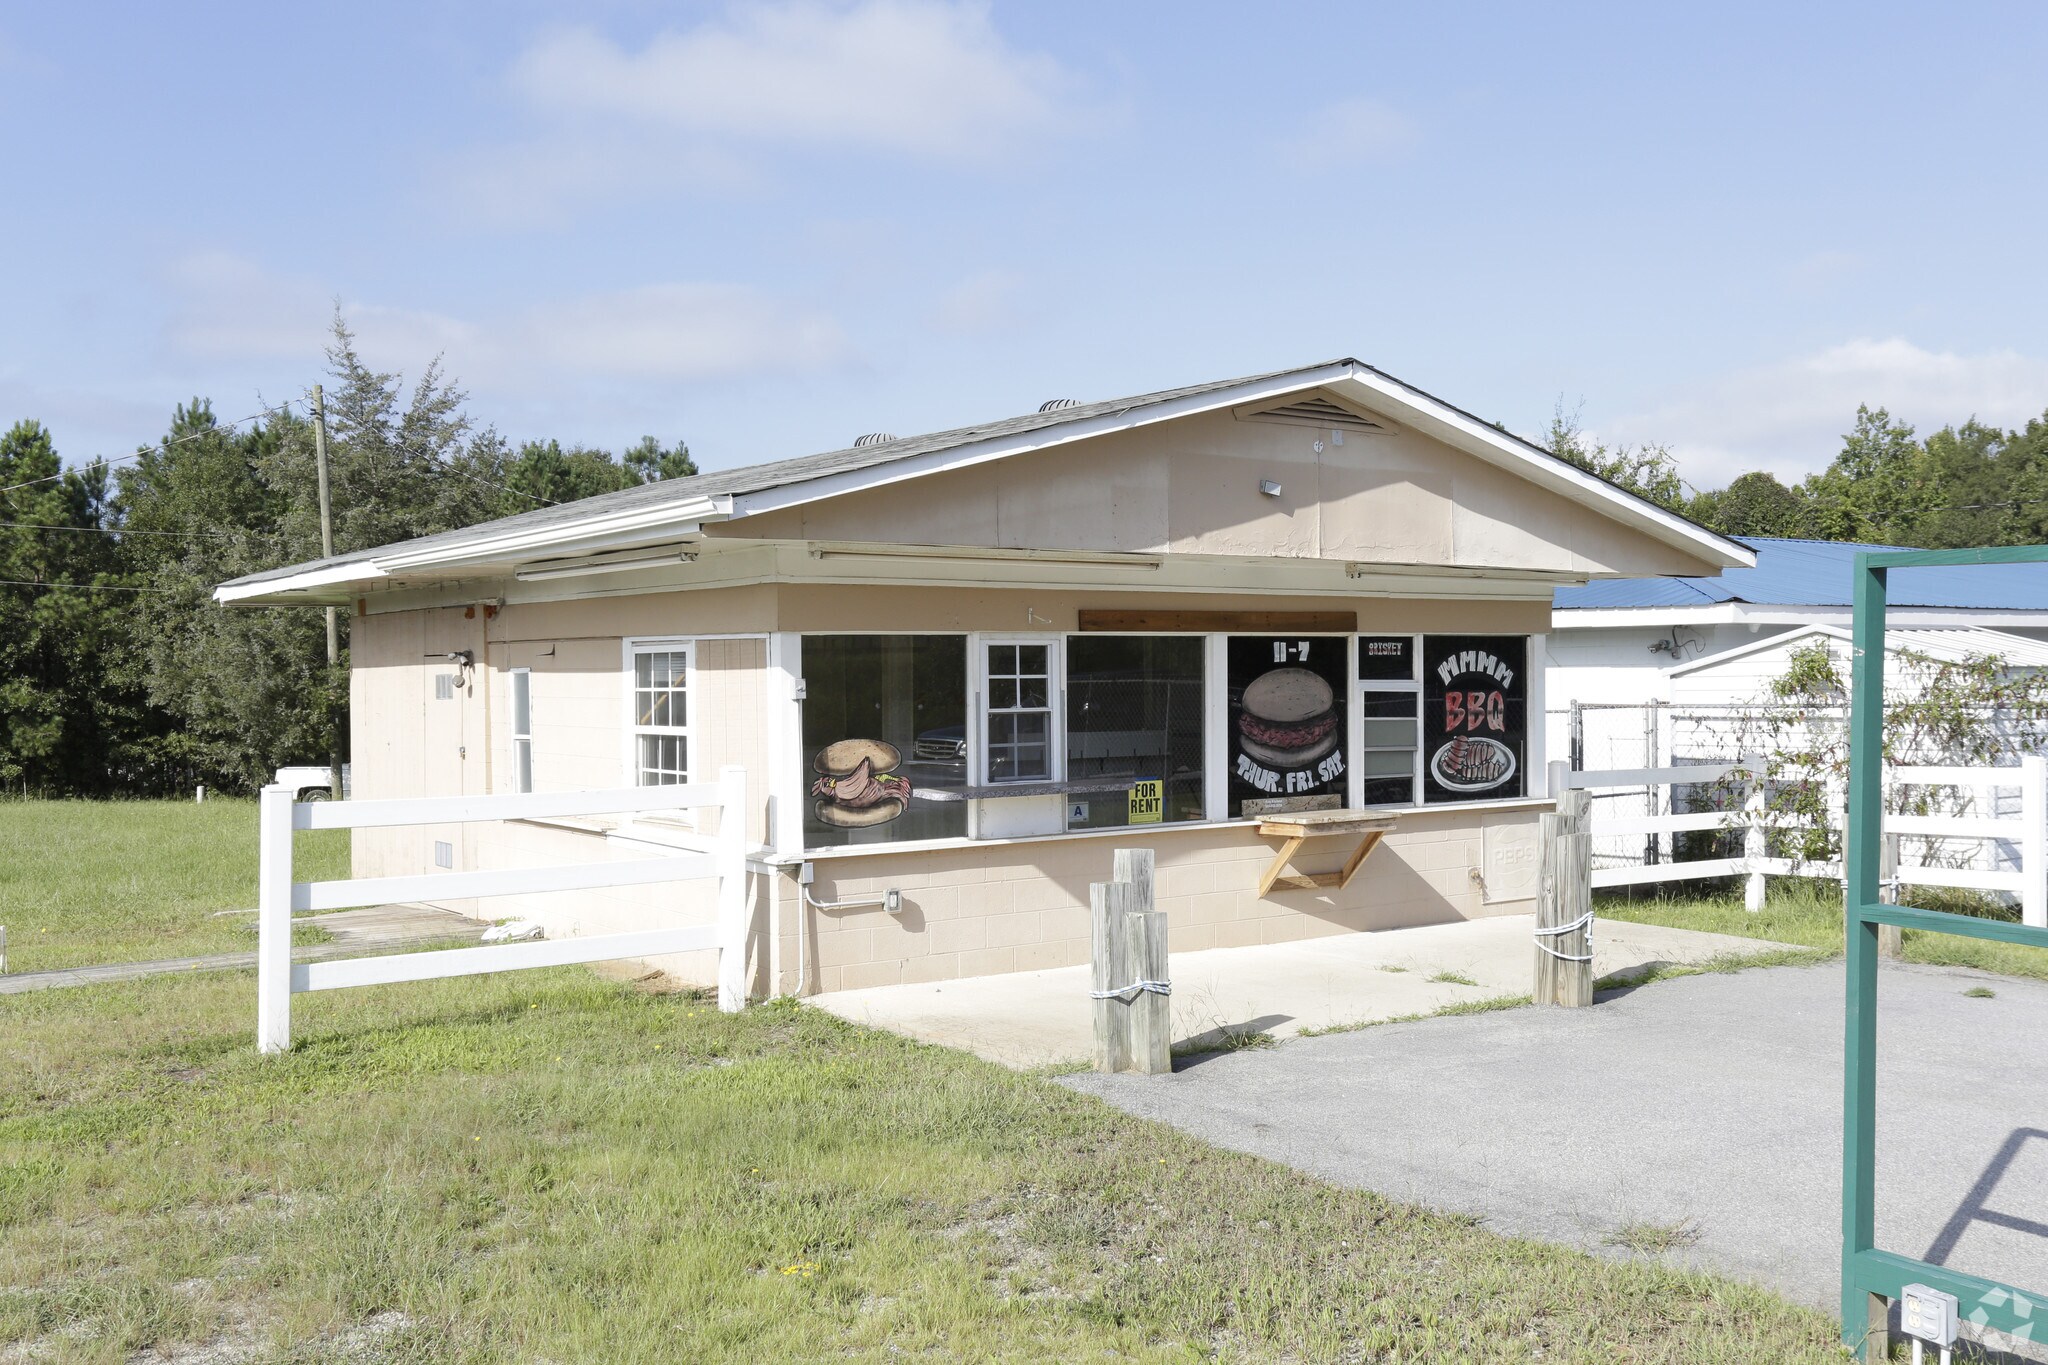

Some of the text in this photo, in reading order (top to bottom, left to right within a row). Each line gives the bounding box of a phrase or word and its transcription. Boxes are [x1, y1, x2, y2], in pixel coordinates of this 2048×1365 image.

[1368, 642, 1402, 656] BRISKET
[1437, 650, 1514, 689] MMMM
[1445, 691, 1505, 732] BBQ
[1286, 770, 1320, 793] FRI.
[1134, 783, 1156, 798] FOR
[1074, 805, 1083, 816] A
[1131, 798, 1160, 813] RENT
